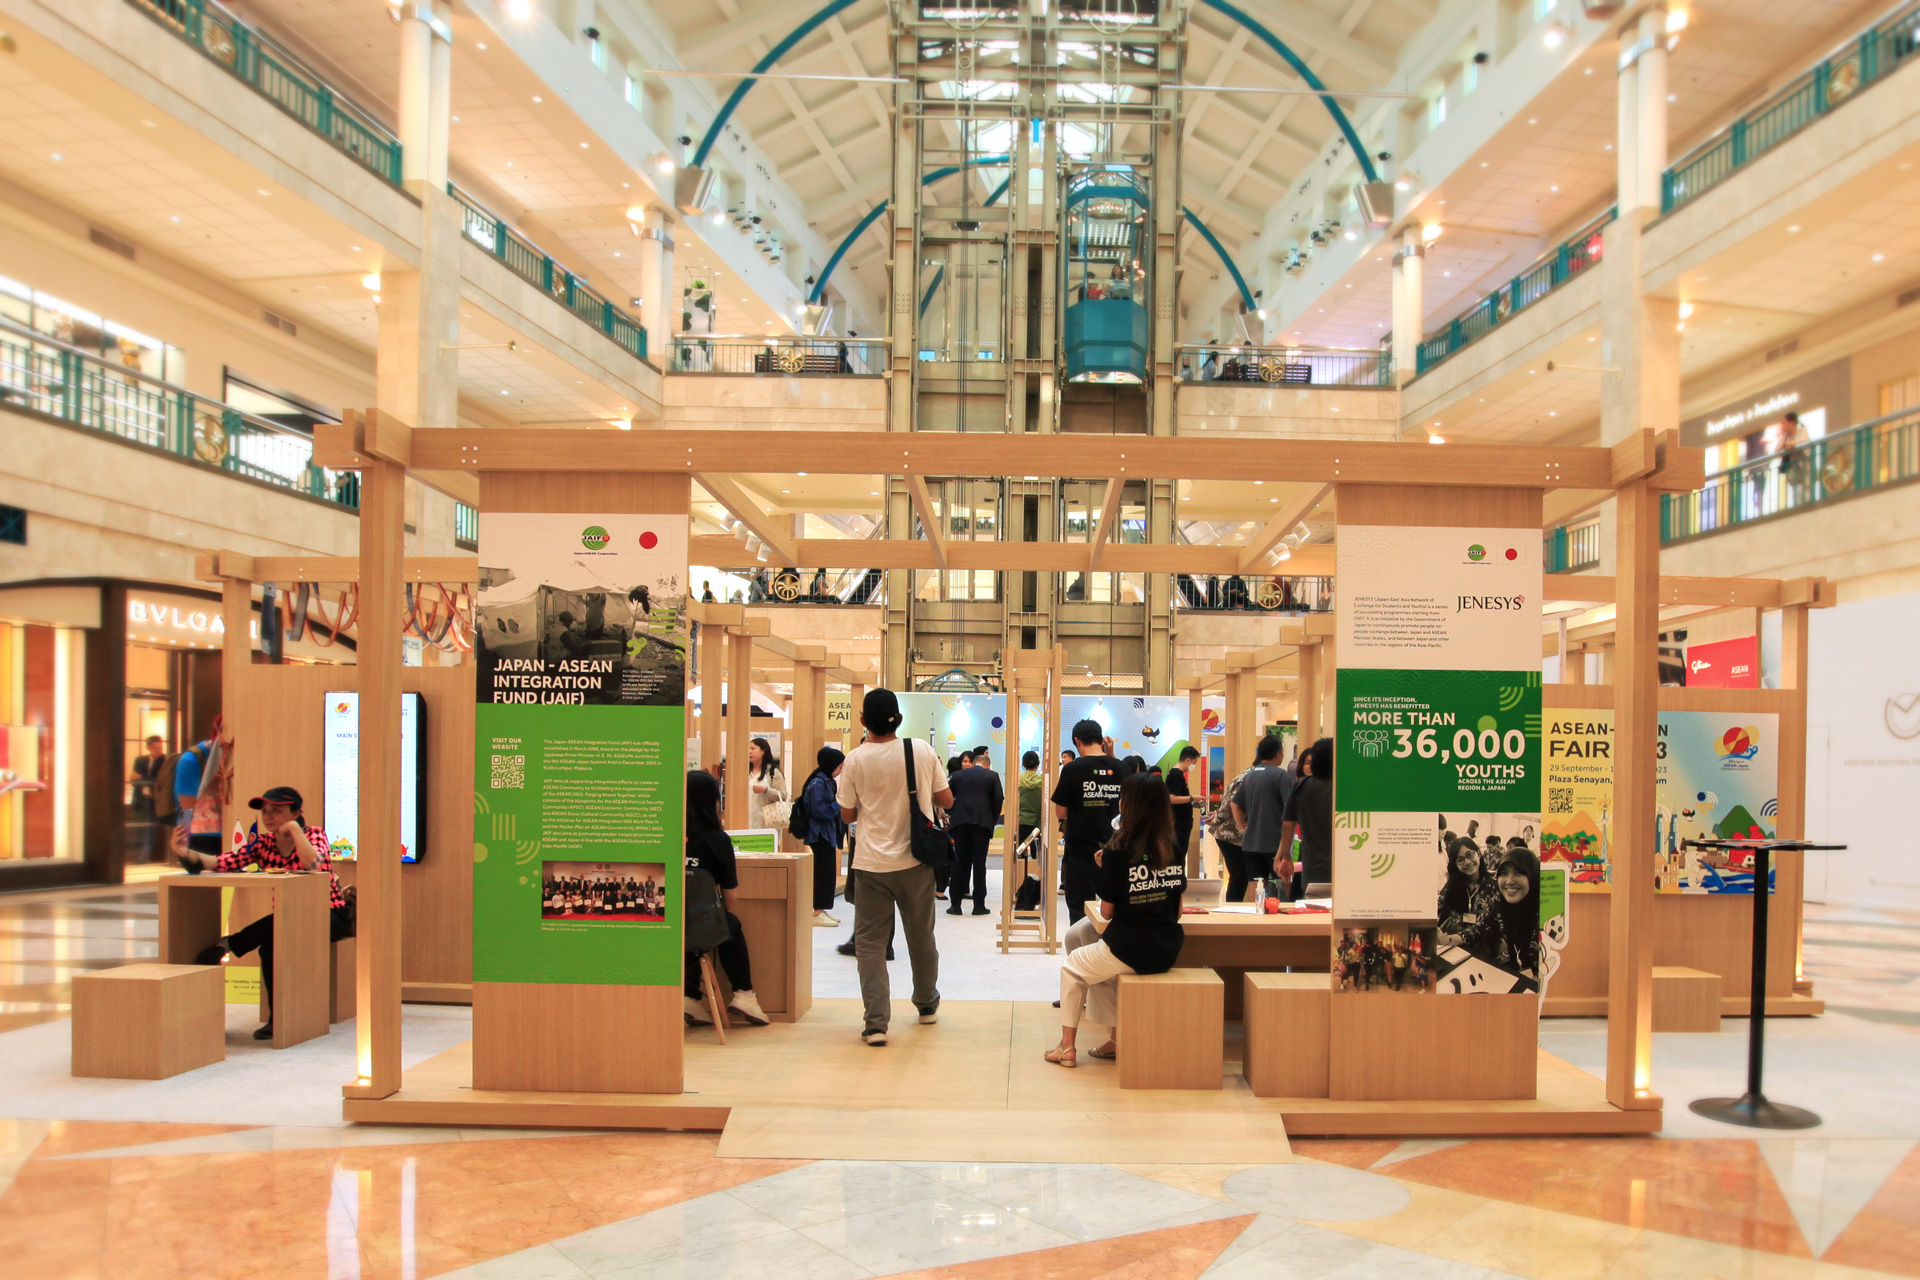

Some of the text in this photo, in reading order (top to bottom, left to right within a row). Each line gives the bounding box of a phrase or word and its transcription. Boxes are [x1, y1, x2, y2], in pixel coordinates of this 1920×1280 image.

[1456, 595, 1522, 613] JENESYS
[129, 600, 257, 638] BVLGAI
[494, 659, 545, 672] JAPAN
[558, 660, 613, 673] ASEAN
[1731, 665, 1749, 674] ASEAN
[493, 675, 602, 689] INTEGRATION
[493, 691, 584, 706] FUND (JAIF)
[828, 712, 849, 720] FAI
[1354, 712, 1455, 726] MORE THAN
[1392, 728, 1526, 764] 36,000
[1550, 740, 1610, 758] FAIR
[1455, 764, 1525, 778] YOUTHS
[1083, 781, 1096, 791] 50
[1574, 776, 1612, 785] Senayan,
[1128, 864, 1182, 882] 50 years
[1129, 878, 1181, 892] ASEAN-Japan
